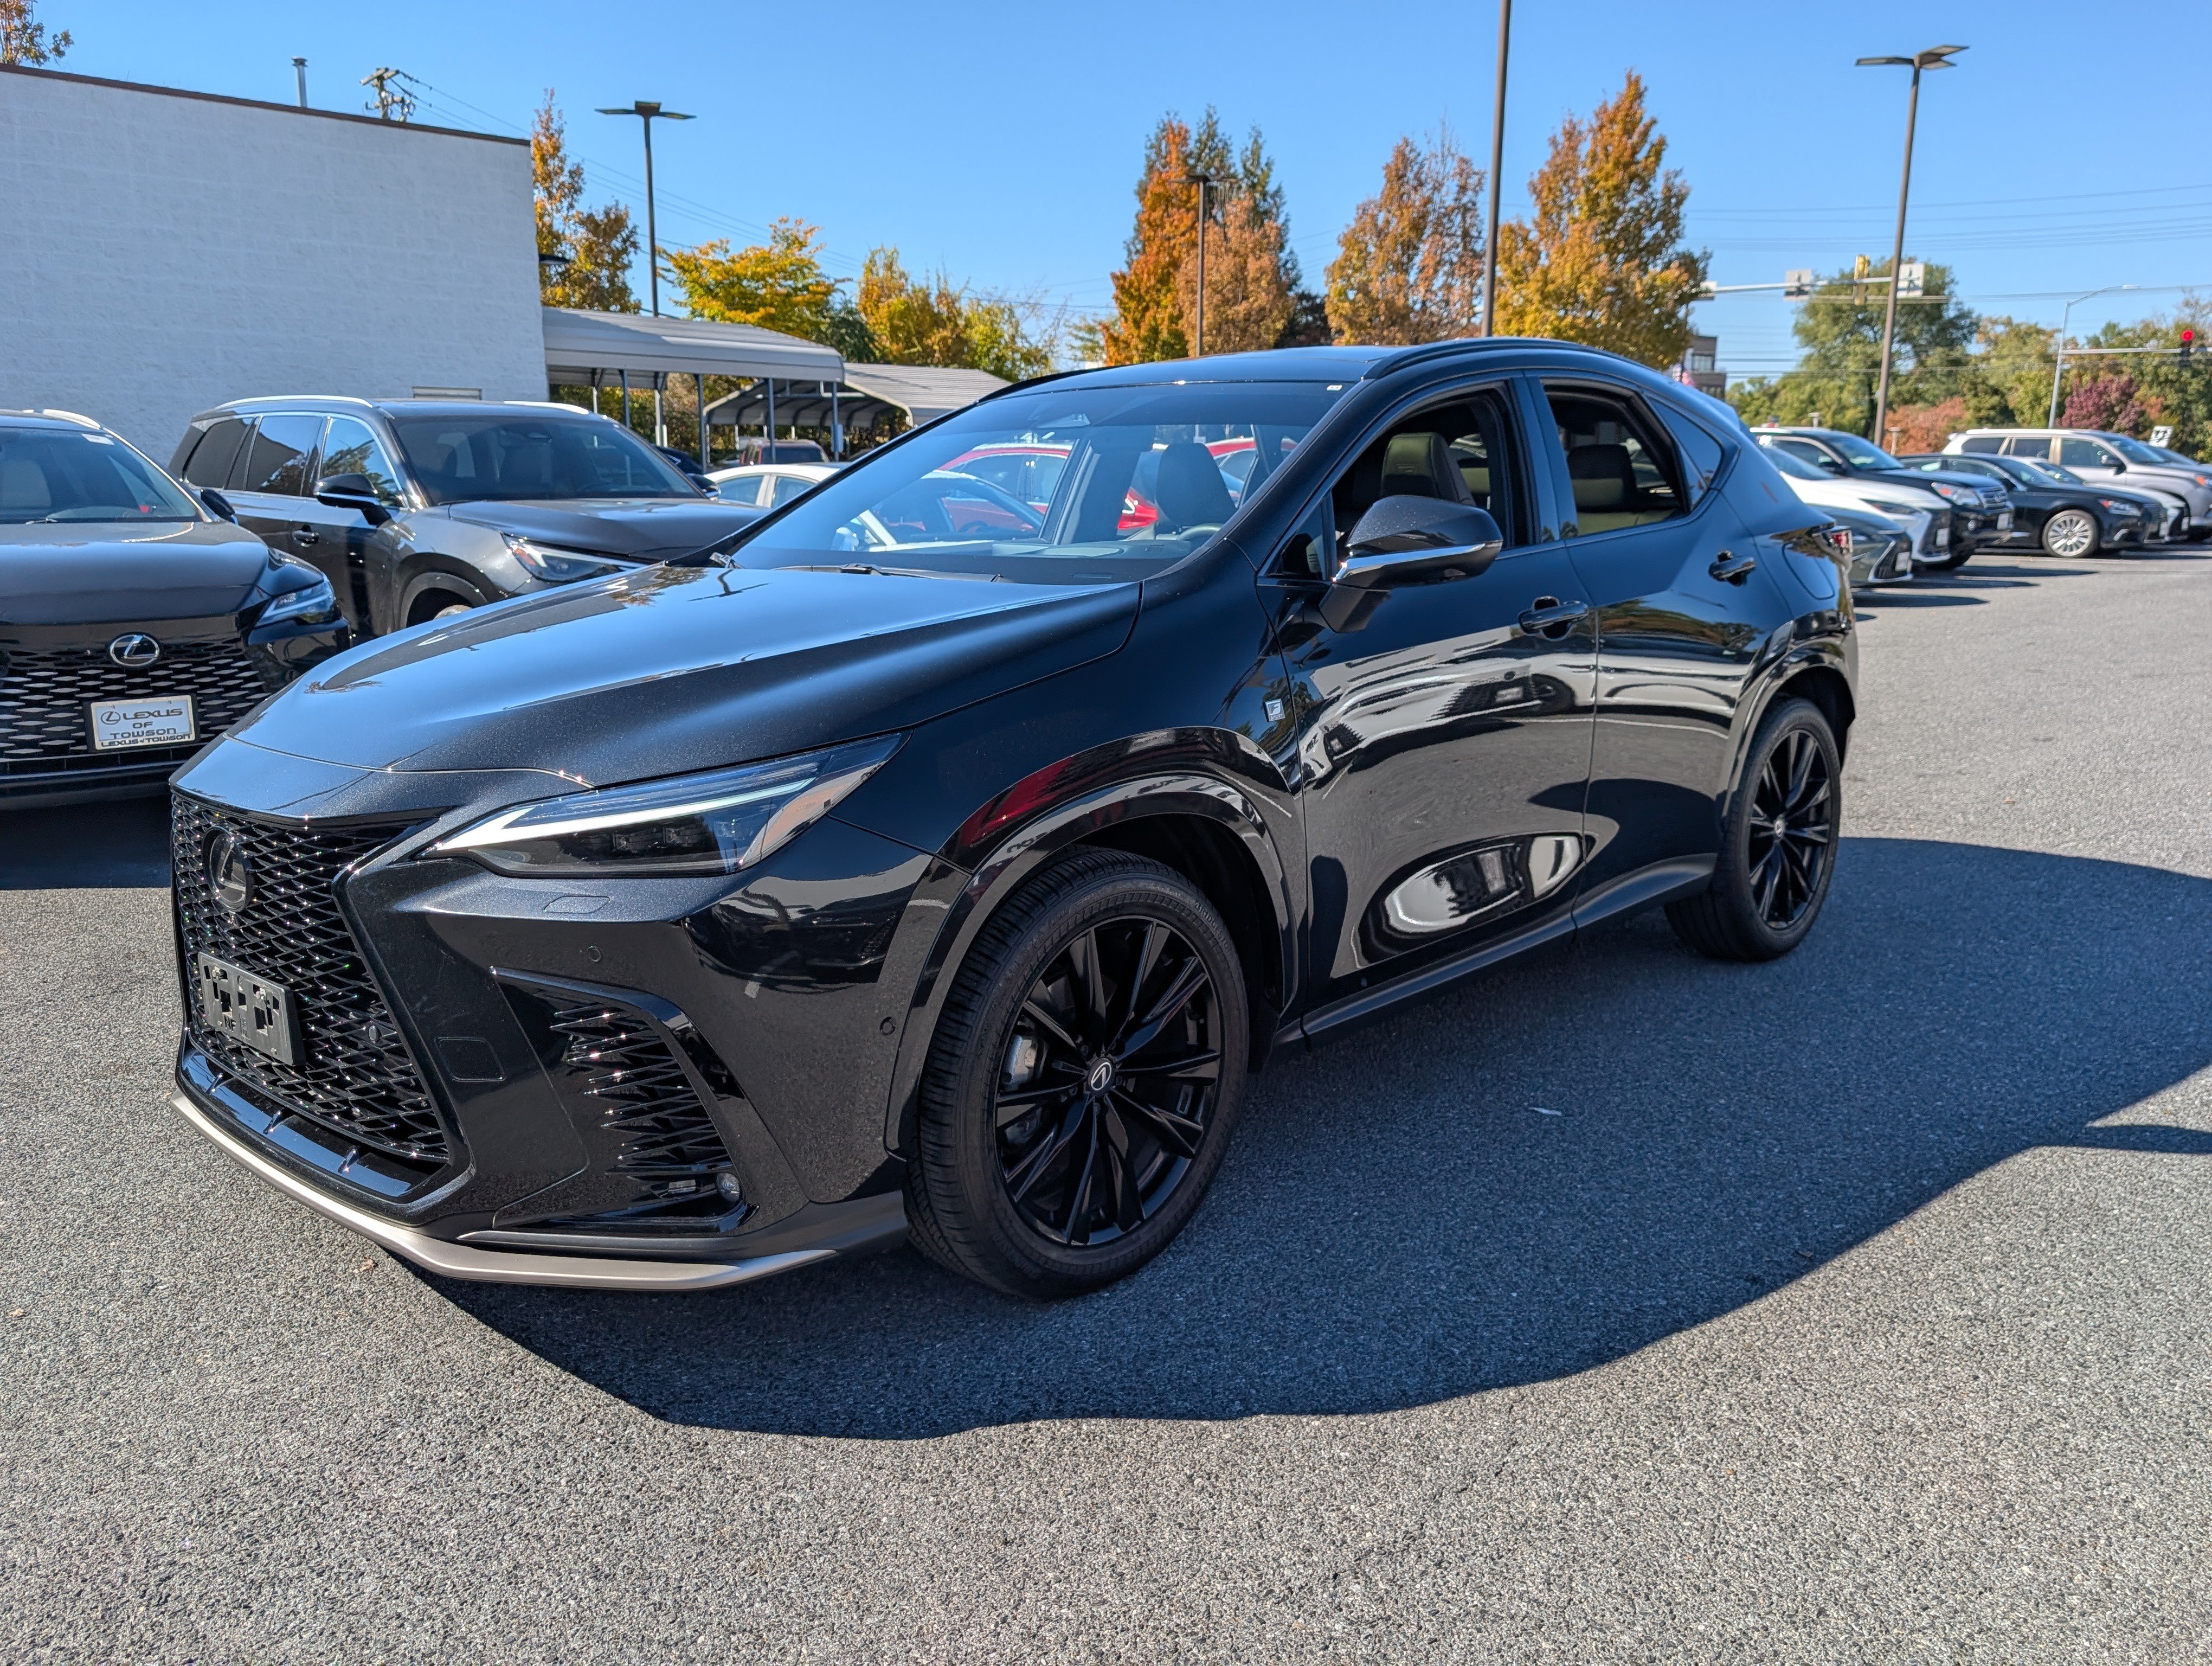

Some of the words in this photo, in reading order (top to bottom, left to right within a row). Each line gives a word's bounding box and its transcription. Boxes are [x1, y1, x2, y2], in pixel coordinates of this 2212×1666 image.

[123, 708, 183, 720] LEXUS
[110, 728, 177, 739] TOWSON
[101, 739, 139, 747] LEXUS
[145, 734, 191, 743] TOWSON
